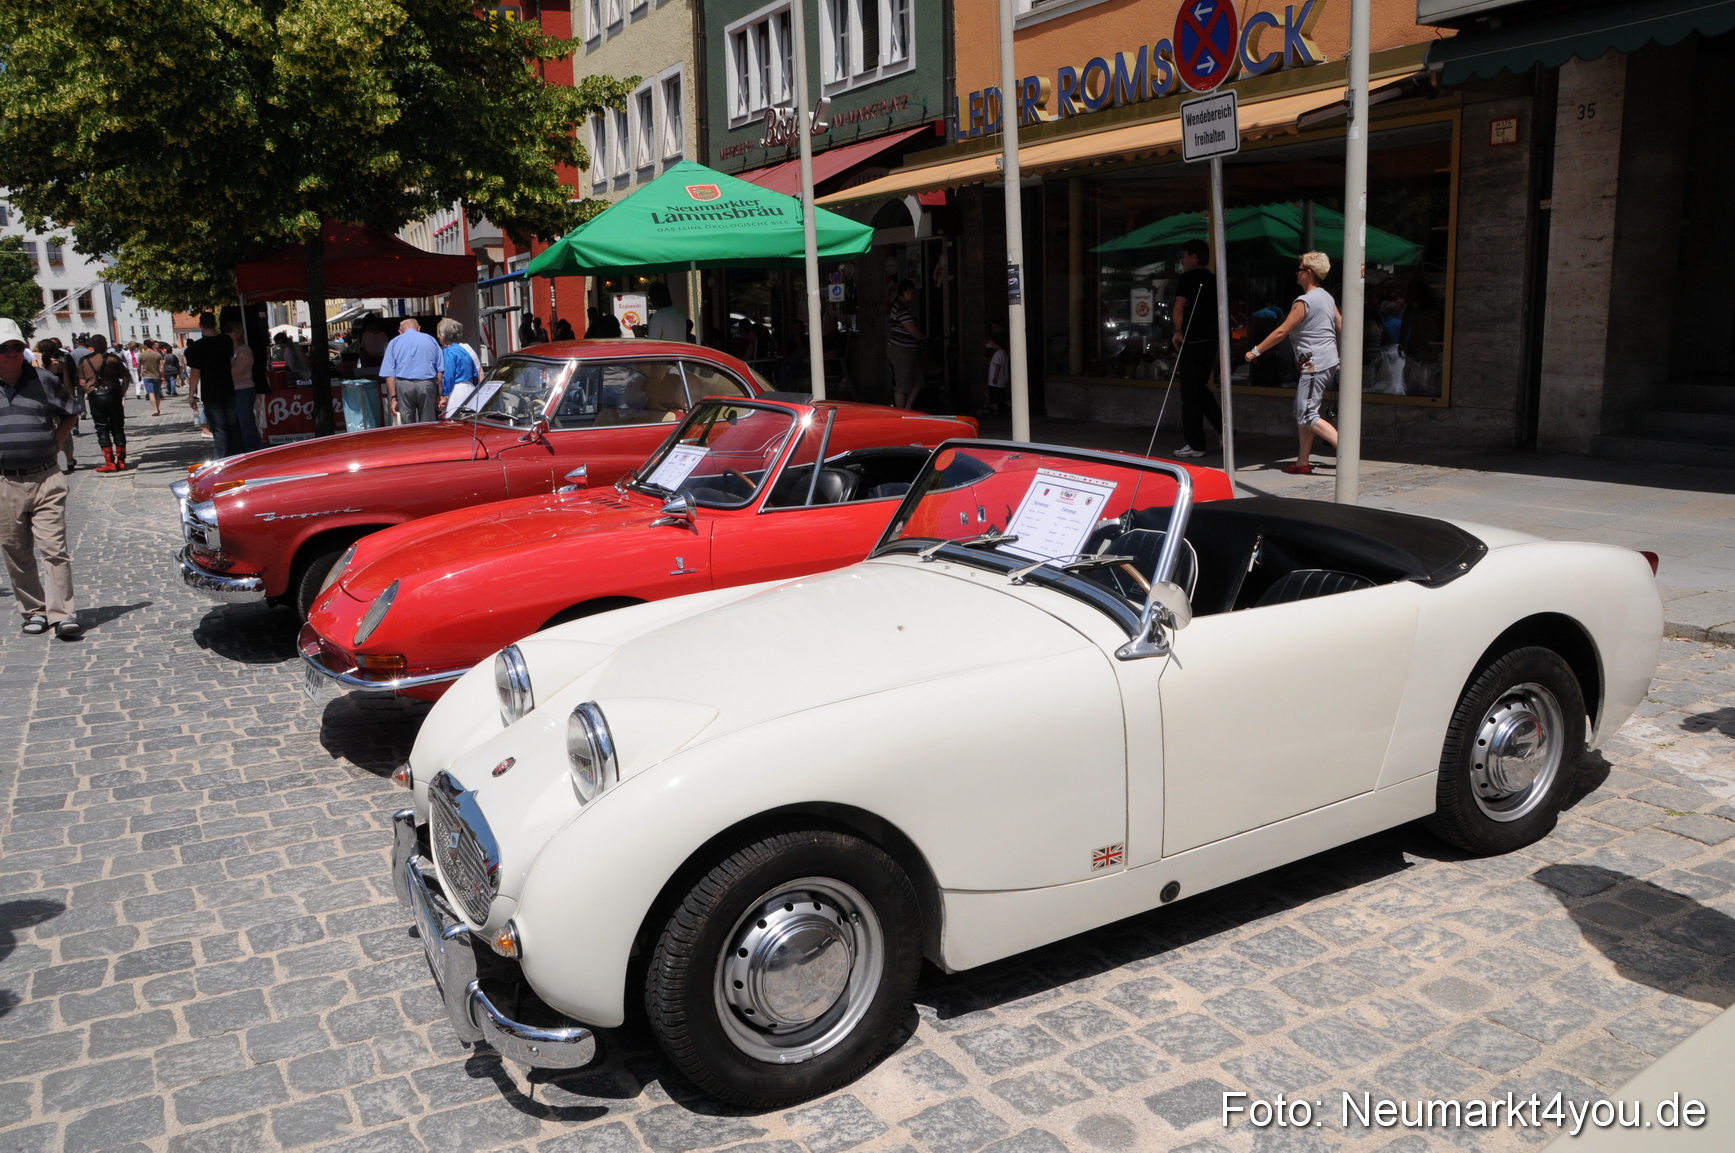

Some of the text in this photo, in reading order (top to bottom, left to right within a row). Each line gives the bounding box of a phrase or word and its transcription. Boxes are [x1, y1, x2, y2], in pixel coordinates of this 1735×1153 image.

[1057, 0, 1324, 118] ROMSCK
[1185, 104, 1232, 127] Wendebereich
[1577, 102, 1596, 120] 35
[760, 97, 830, 147] Bögl
[1194, 129, 1226, 147] freihalten
[666, 199, 760, 212] Neumarkter
[651, 206, 784, 225] Lammsbräu
[704, 221, 768, 230] ÖKOLOGISCHE
